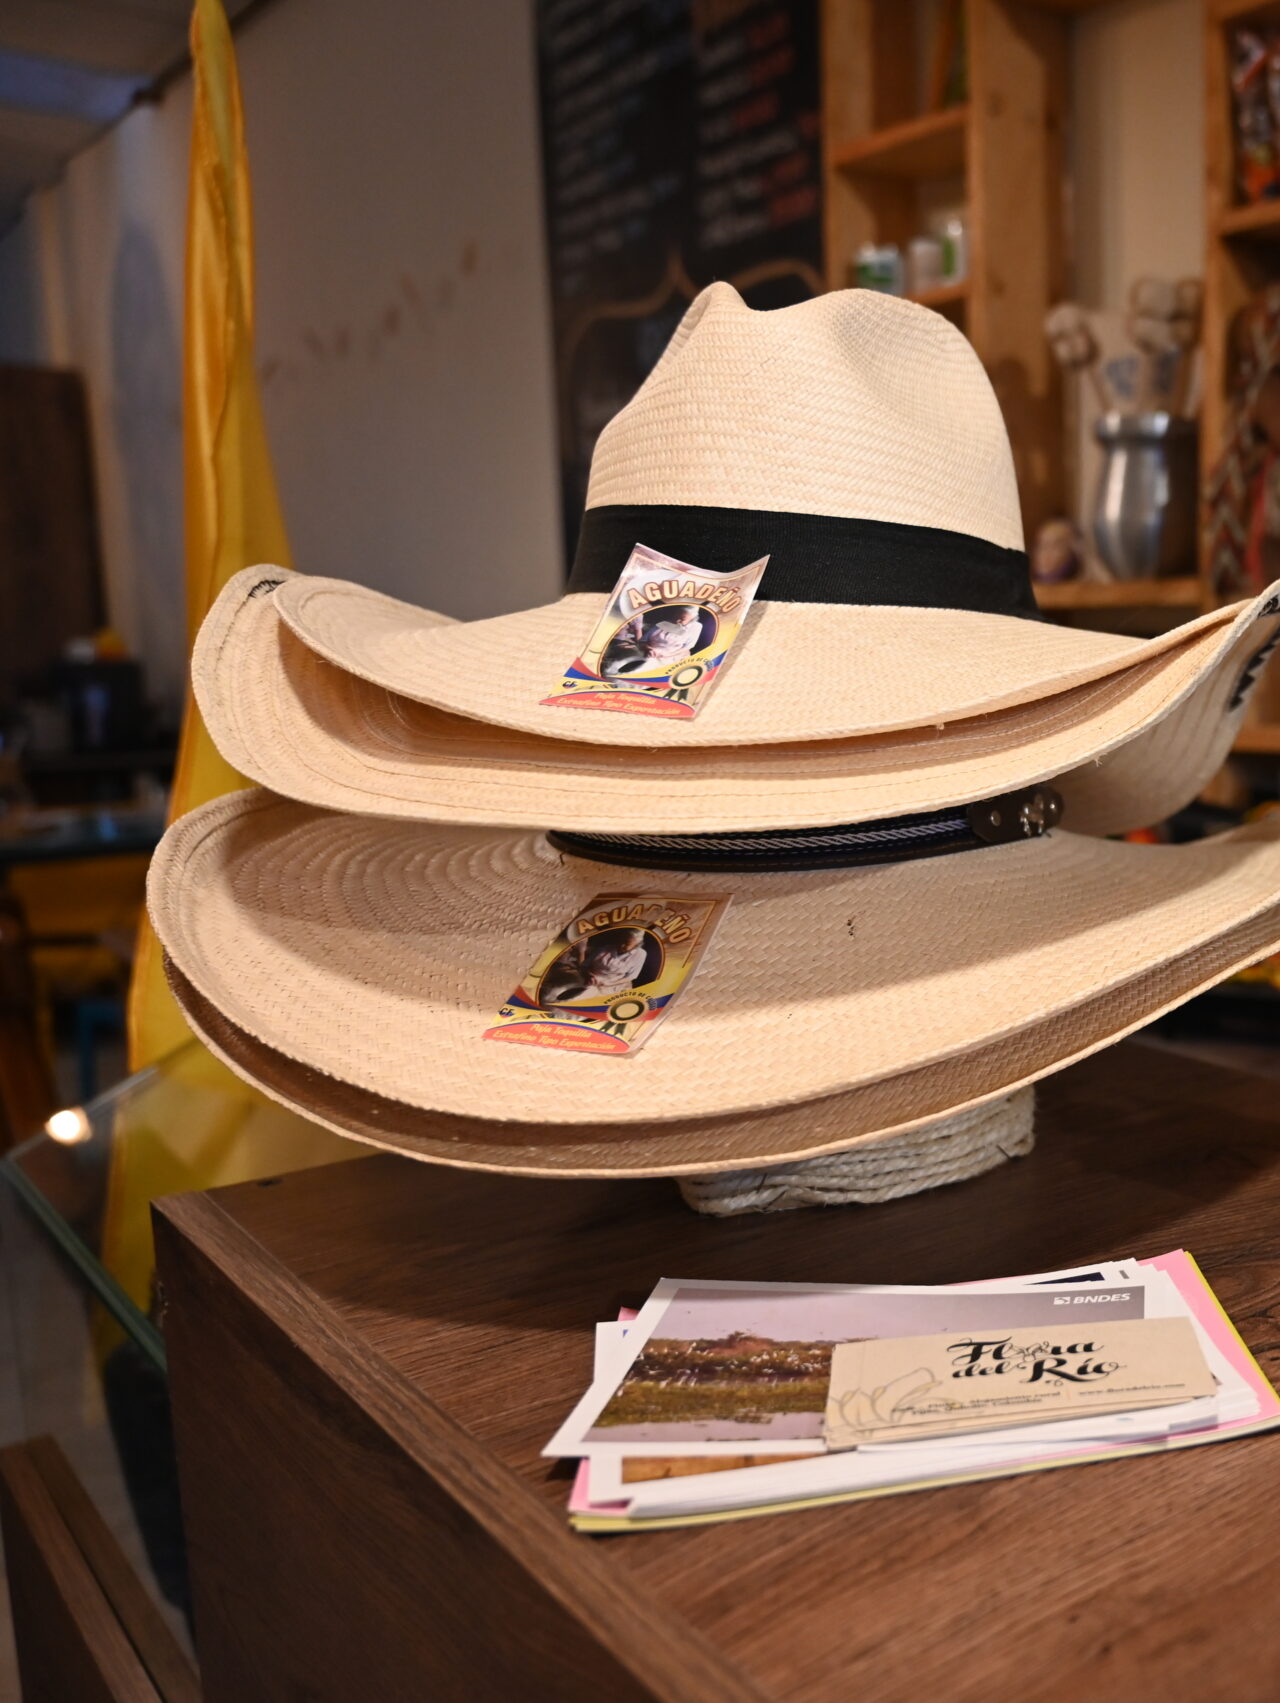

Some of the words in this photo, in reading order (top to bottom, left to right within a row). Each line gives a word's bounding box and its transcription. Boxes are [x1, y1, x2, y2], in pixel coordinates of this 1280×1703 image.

[627, 580, 742, 613] AGUADEÑO
[1073, 1293, 1131, 1304] BNDES
[952, 1360, 1016, 1378] del
